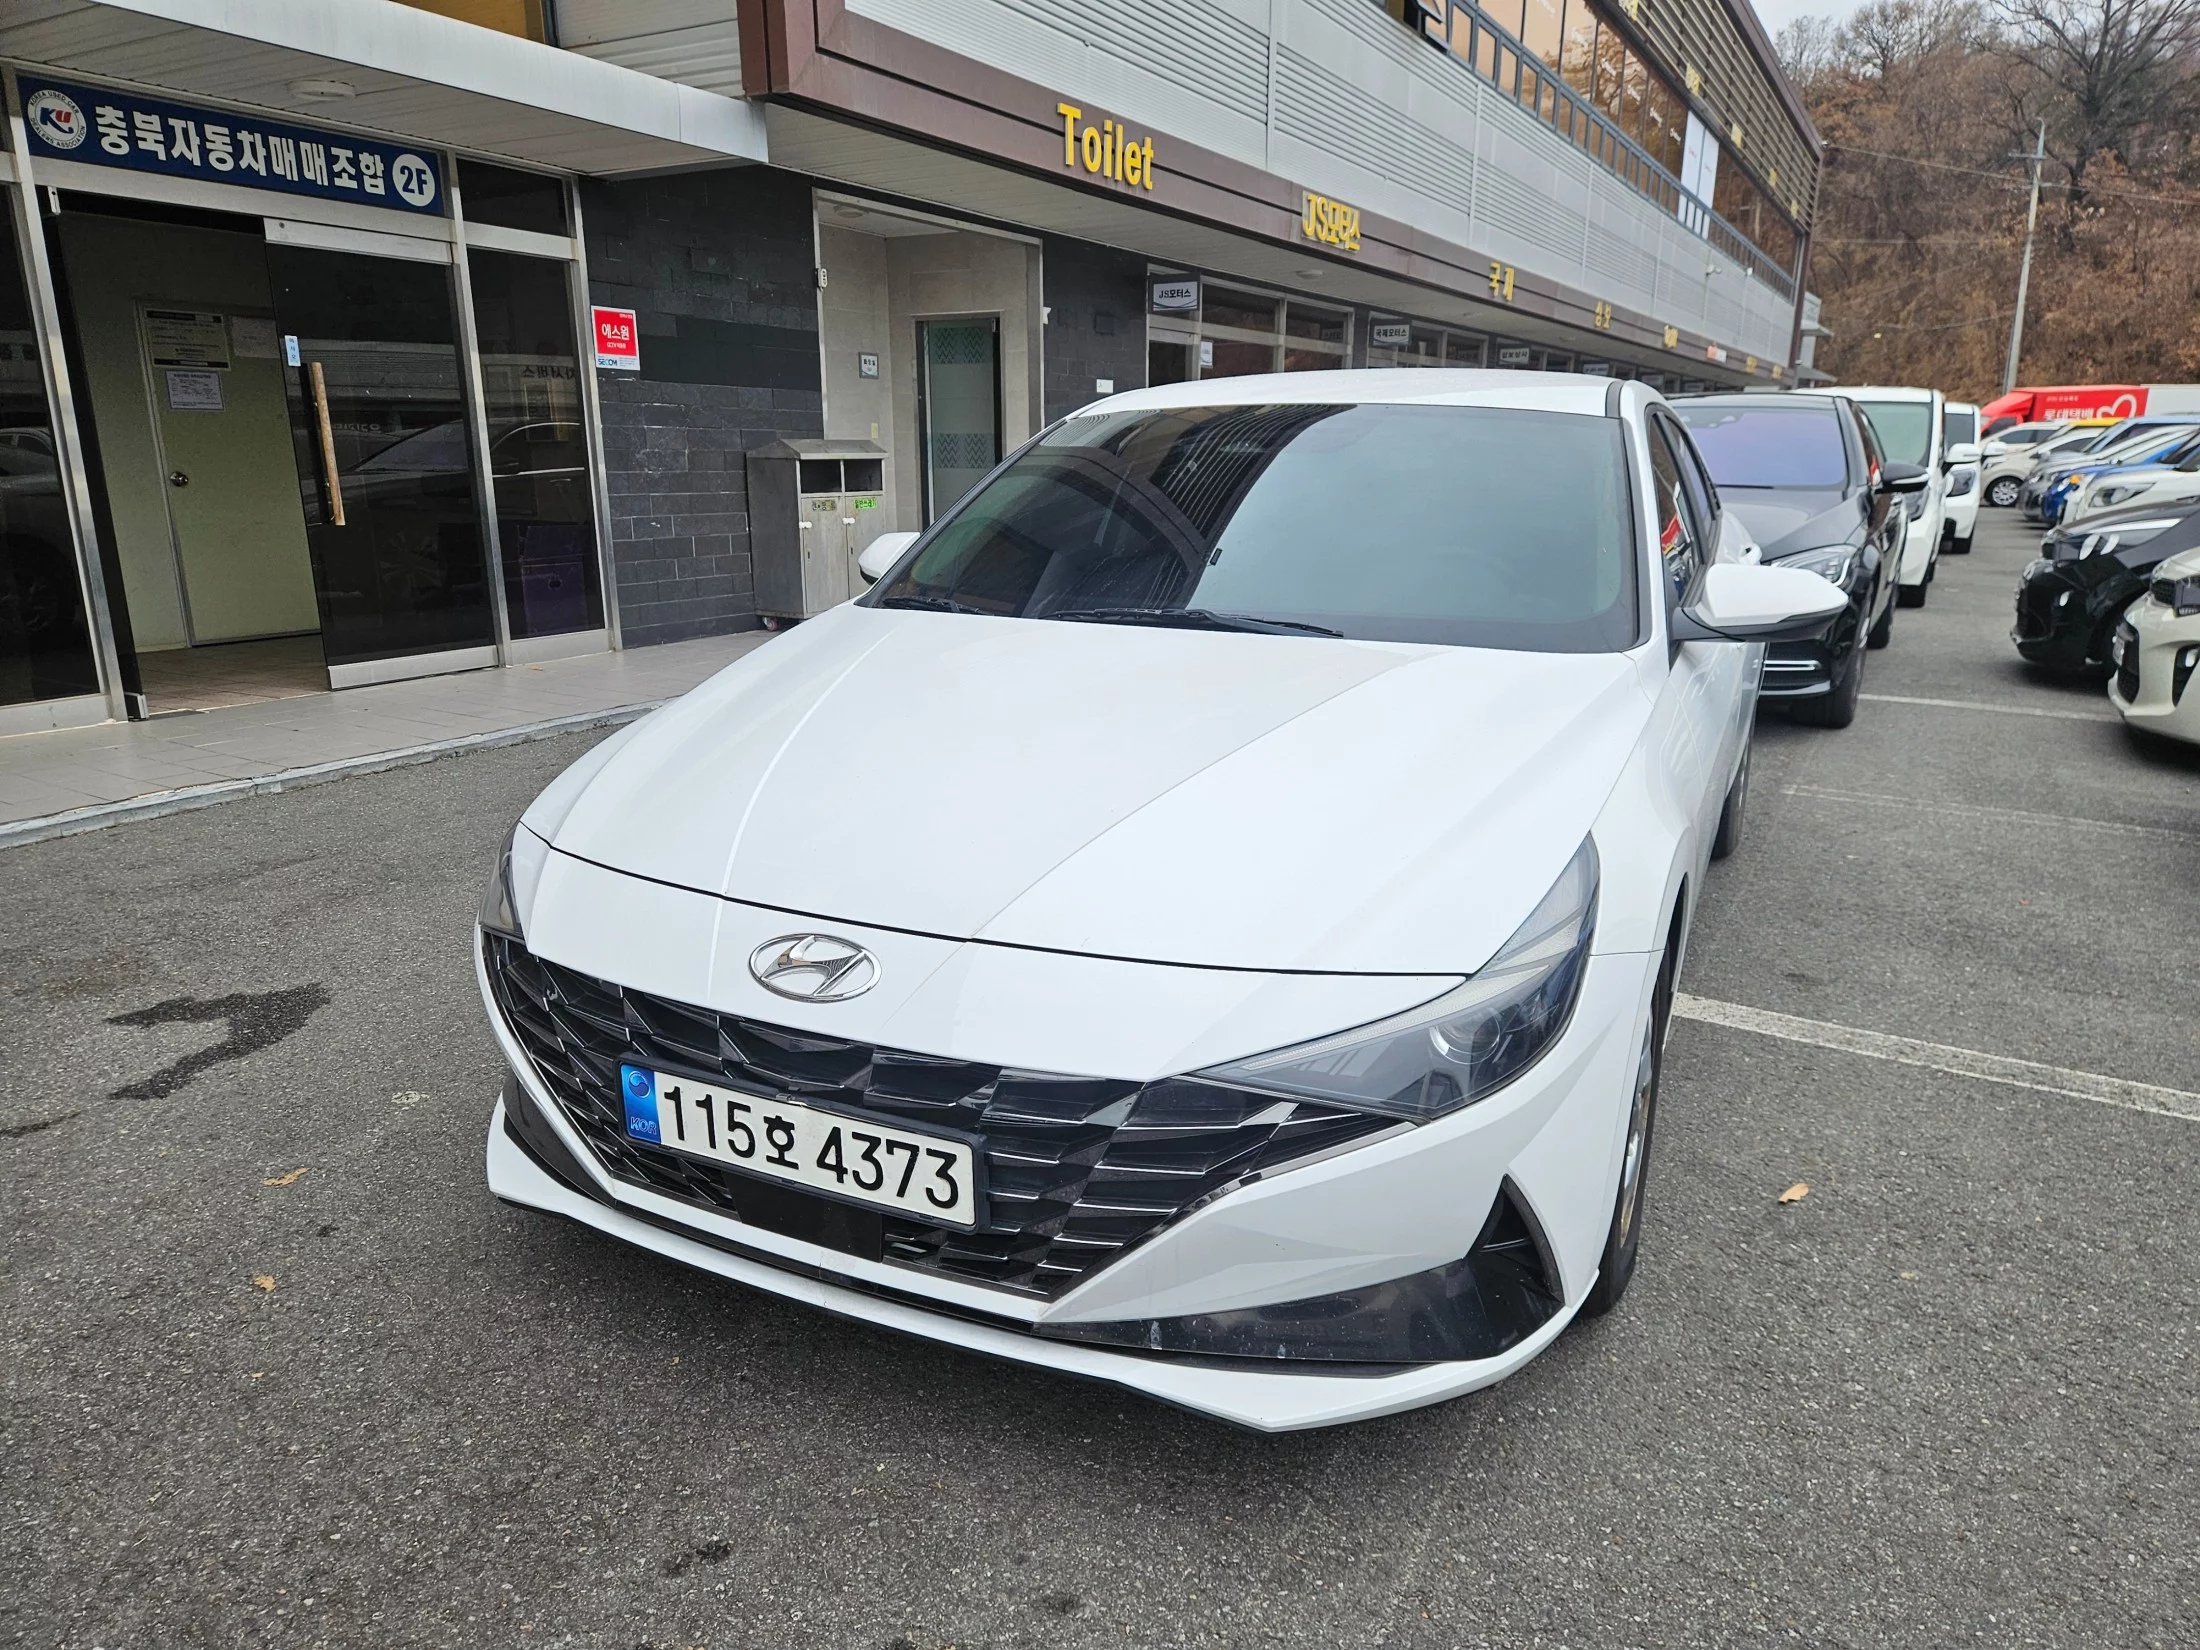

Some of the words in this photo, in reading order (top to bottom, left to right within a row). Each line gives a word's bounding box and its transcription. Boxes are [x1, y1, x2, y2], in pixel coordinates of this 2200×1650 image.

[94, 105, 387, 196] 충북자동차매매조합
[398, 164, 430, 197] 2F
[1057, 102, 1155, 190] Toilet
[1303, 193, 1361, 251] JS모터스
[1158, 288, 1192, 299] JS모터스
[601, 323, 630, 340] 에스원
[1375, 327, 1408, 338] 국제모터스
[629, 1115, 658, 1135] KOR
[663, 1085, 799, 1170] 115호
[816, 1126, 959, 1209] 4373
